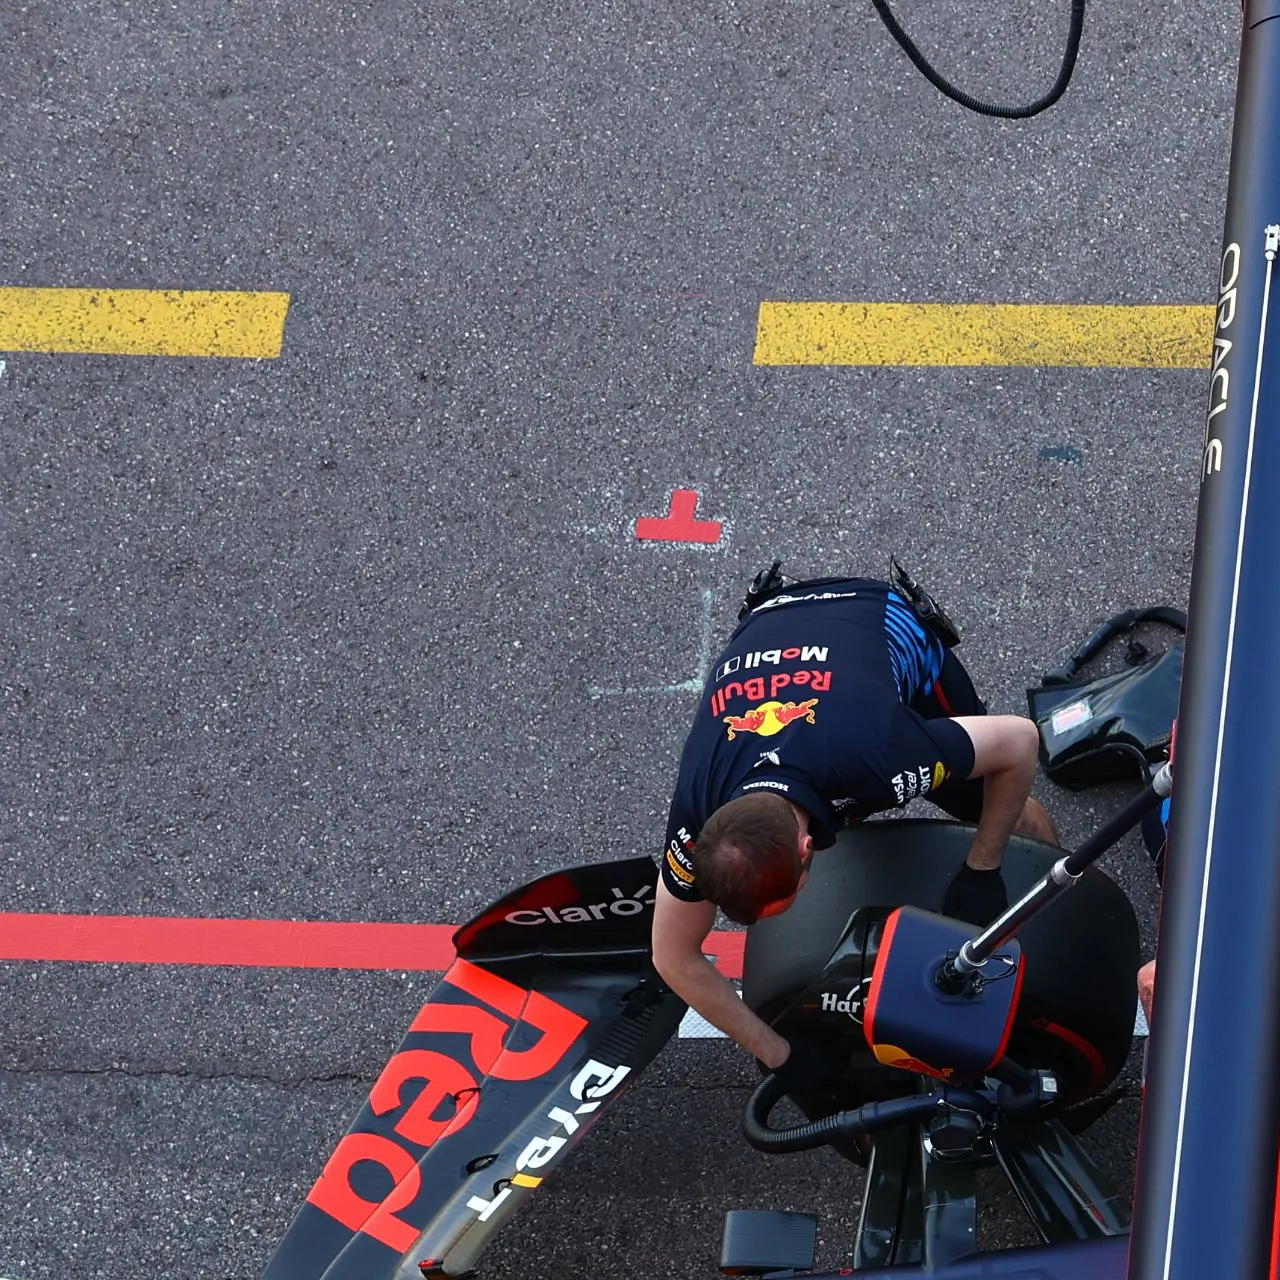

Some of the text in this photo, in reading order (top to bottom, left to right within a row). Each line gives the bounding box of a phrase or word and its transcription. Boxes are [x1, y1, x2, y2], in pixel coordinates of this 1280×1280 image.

[745, 646, 829, 669] Mobil
[711, 671, 832, 717] Red Bull
[504, 893, 644, 928] Claro
[307, 956, 590, 1254] Red
[466, 1058, 631, 1224] BYBIT
